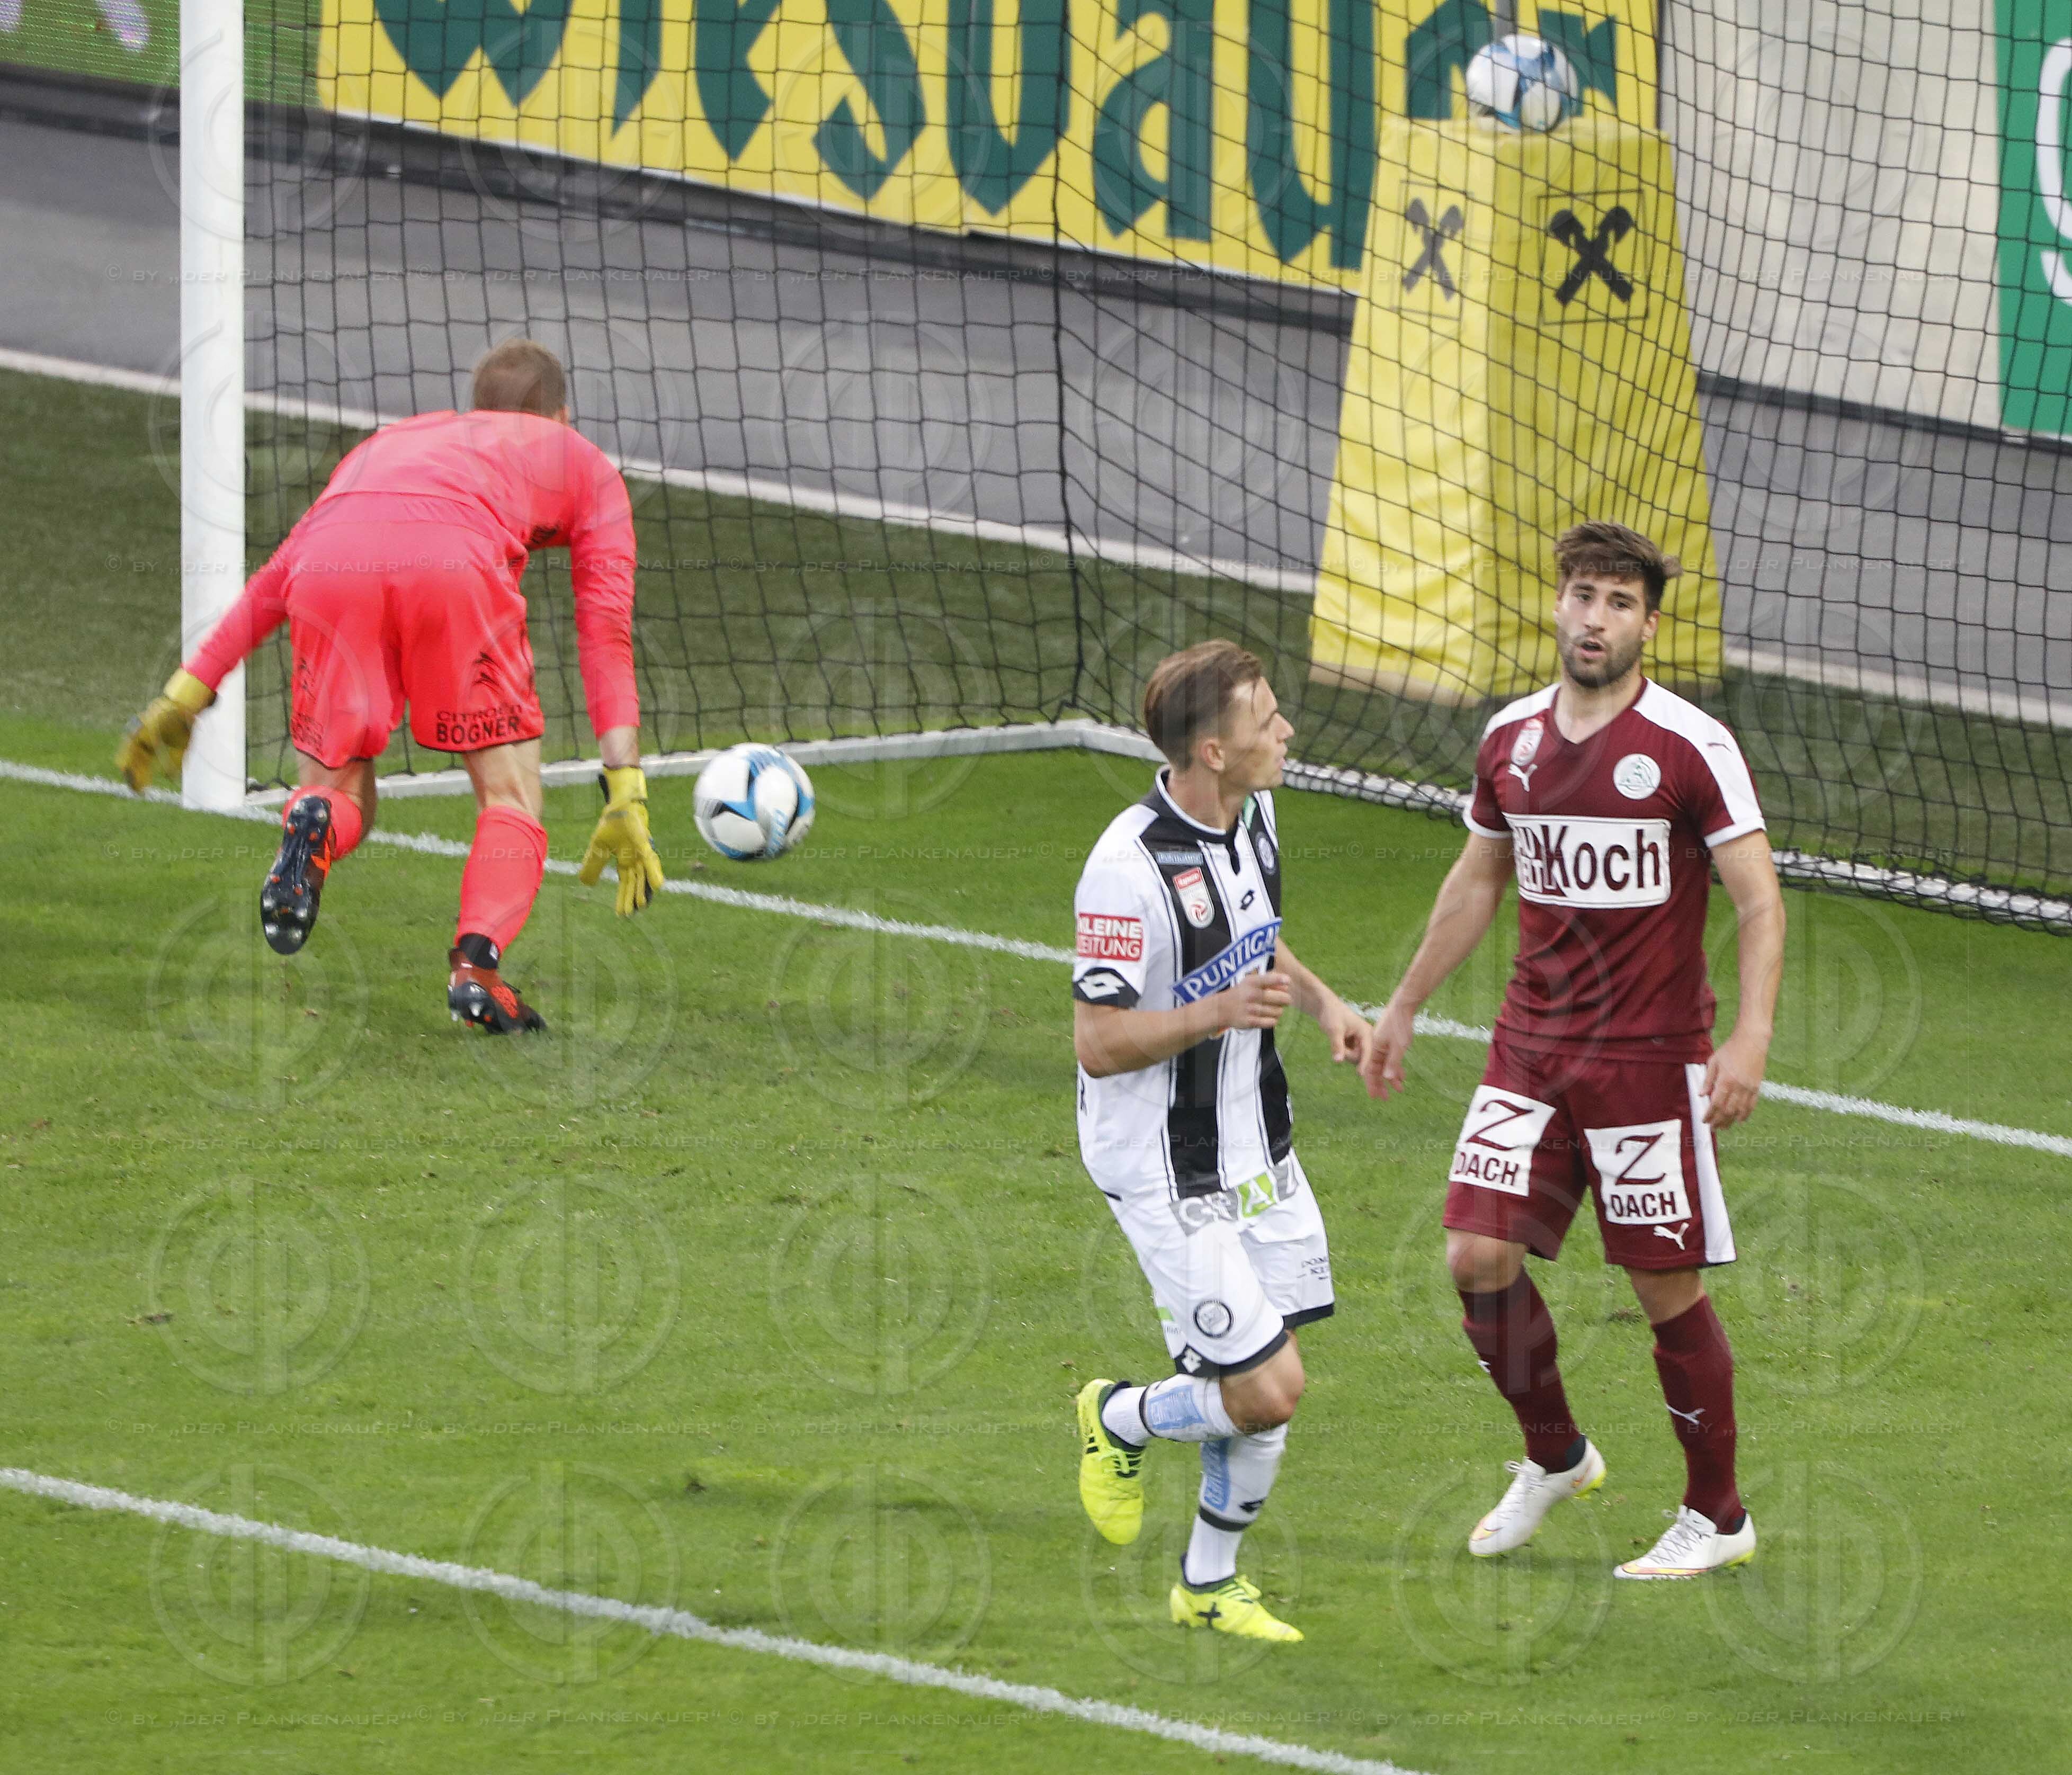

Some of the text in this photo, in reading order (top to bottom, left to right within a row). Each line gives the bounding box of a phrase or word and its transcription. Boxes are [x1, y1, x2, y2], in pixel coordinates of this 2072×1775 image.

[436, 716, 521, 744] BOGNER
[1540, 824, 1661, 891] Koch
[1610, 1191, 1678, 1217] DACH
